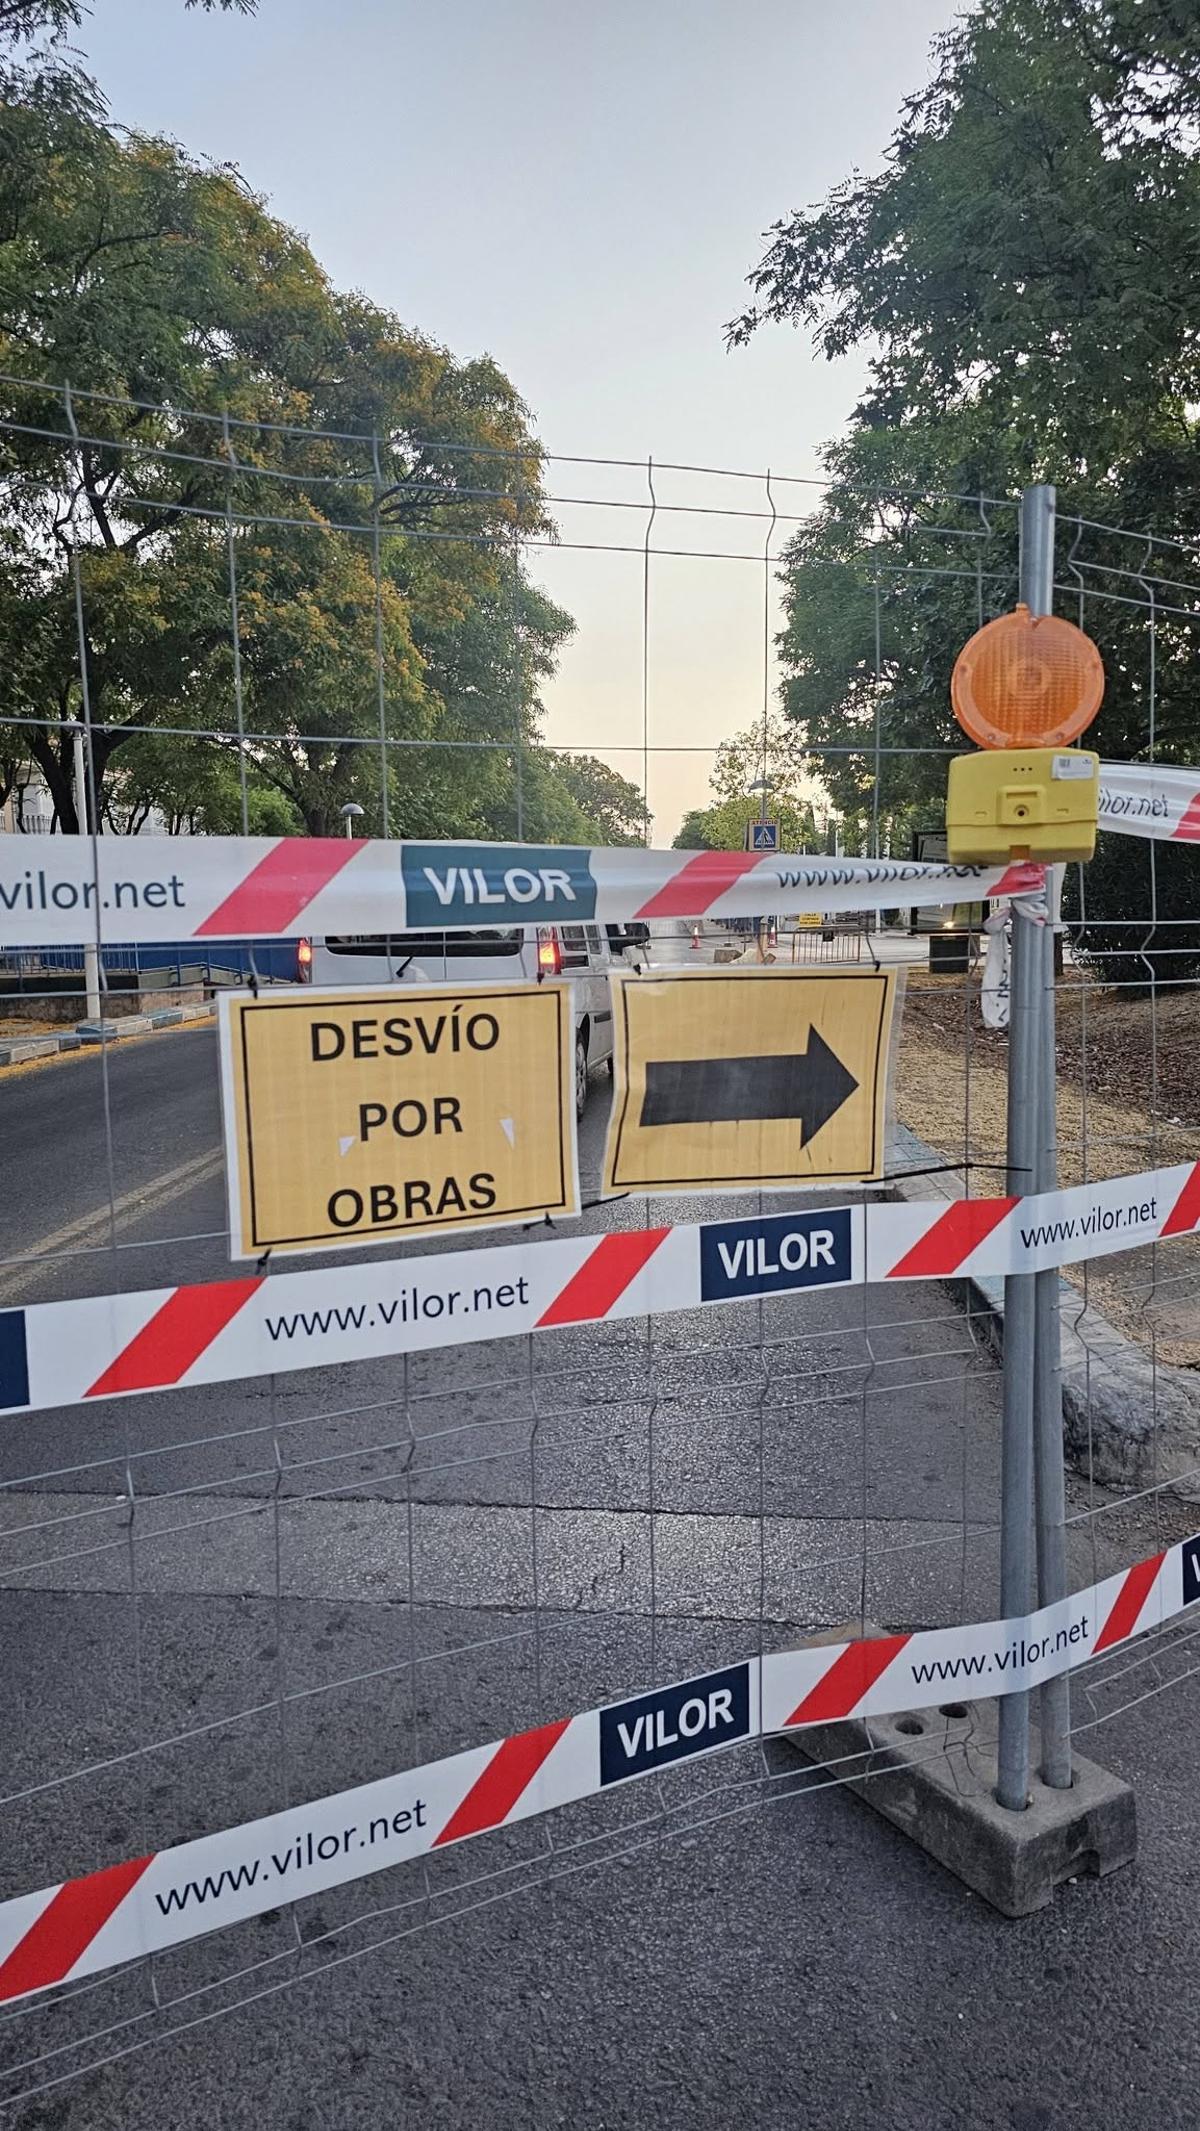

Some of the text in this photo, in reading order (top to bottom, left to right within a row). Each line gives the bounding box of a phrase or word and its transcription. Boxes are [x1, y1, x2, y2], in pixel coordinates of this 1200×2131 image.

[1098, 787, 1169, 818] ilor.net
[423, 867, 577, 905] VILOR
[310, 1004, 500, 1062] DESVÍO
[359, 1096, 463, 1142] POR
[327, 1173, 497, 1228] OBRAS
[1020, 1198, 1157, 1250] www.vilor.net
[717, 1229, 836, 1279] VILOR
[265, 1276, 530, 1341] www.vilor.net
[911, 1616, 1089, 1684] www.vilor.net
[616, 1687, 734, 1759] VILOR
[155, 1799, 428, 1916] www.vilor.net
